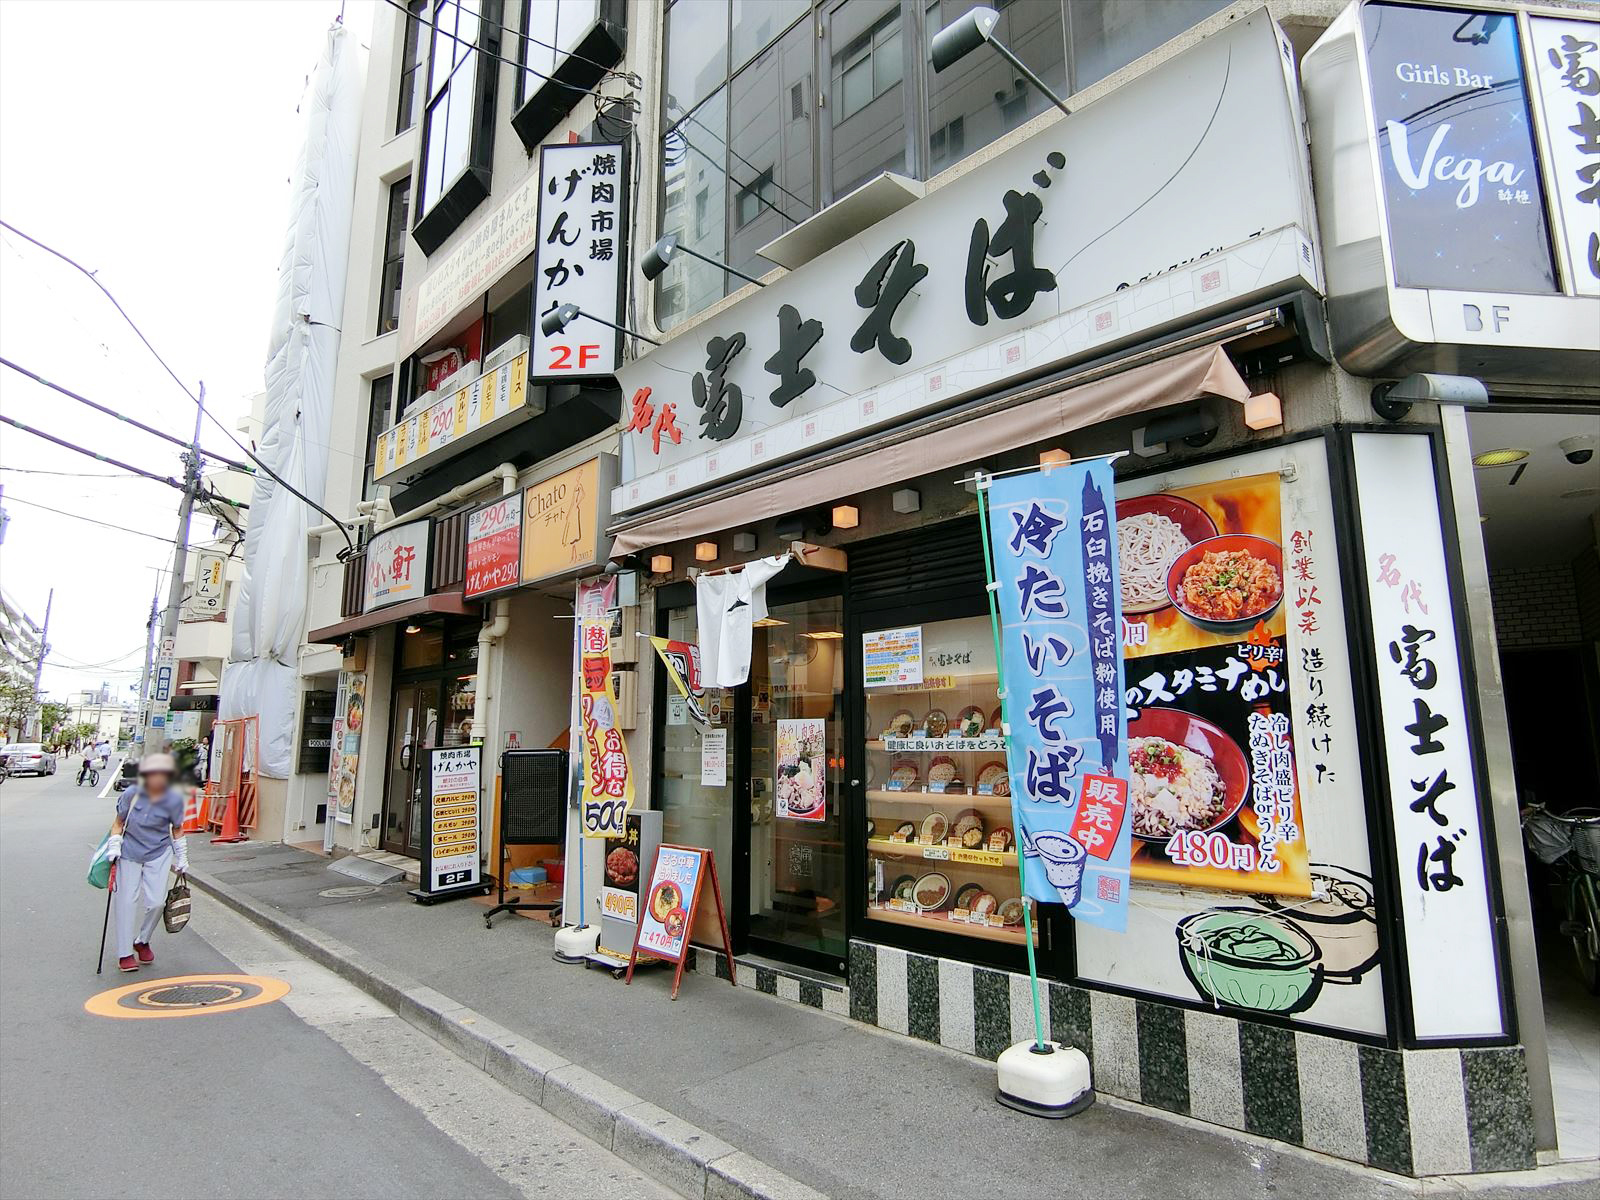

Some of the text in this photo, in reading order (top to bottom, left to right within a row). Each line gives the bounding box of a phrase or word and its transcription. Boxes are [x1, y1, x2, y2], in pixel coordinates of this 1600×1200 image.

[1395, 61, 1494, 89] Girls Bar
[1385, 119, 1526, 209] Vega
[1547, 35, 1600, 279] 富士
[589, 153, 616, 261] 焼肉市場
[628, 385, 682, 455] 名代
[690, 151, 1067, 443] 富士そば
[514, 354, 524, 393] ロース
[548, 344, 601, 370] 2F
[458, 390, 467, 424] カルビ
[470, 381, 480, 417] 上ミノ
[527, 483, 568, 519] Chato
[544, 507, 566, 528] チャト
[200, 568, 212, 592] アイム
[1081, 509, 1118, 737] 石臼挽きそば粉使用
[1123, 621, 1147, 646] 円
[938, 651, 973, 667] 富士そば
[1010, 502, 1077, 802] 冷たいそば
[1236, 643, 1284, 663] ピリ辛!
[1290, 529, 1336, 785] 創業以来 造り続けた
[1376, 552, 1467, 892] 名代 富士そば
[434, 760, 477, 773] げんかや
[604, 727, 629, 798] お得な
[1270, 712, 1298, 842] 冷し肉盛ピリ辛
[1250, 713, 1281, 872] たぬきそばorうどん
[585, 799, 628, 835] 500円
[1077, 778, 1125, 850] 販売中
[661, 852, 696, 869] ざる中華
[1166, 831, 1254, 870] 480円
[446, 872, 465, 883] 2F
[605, 891, 636, 919] 490円
